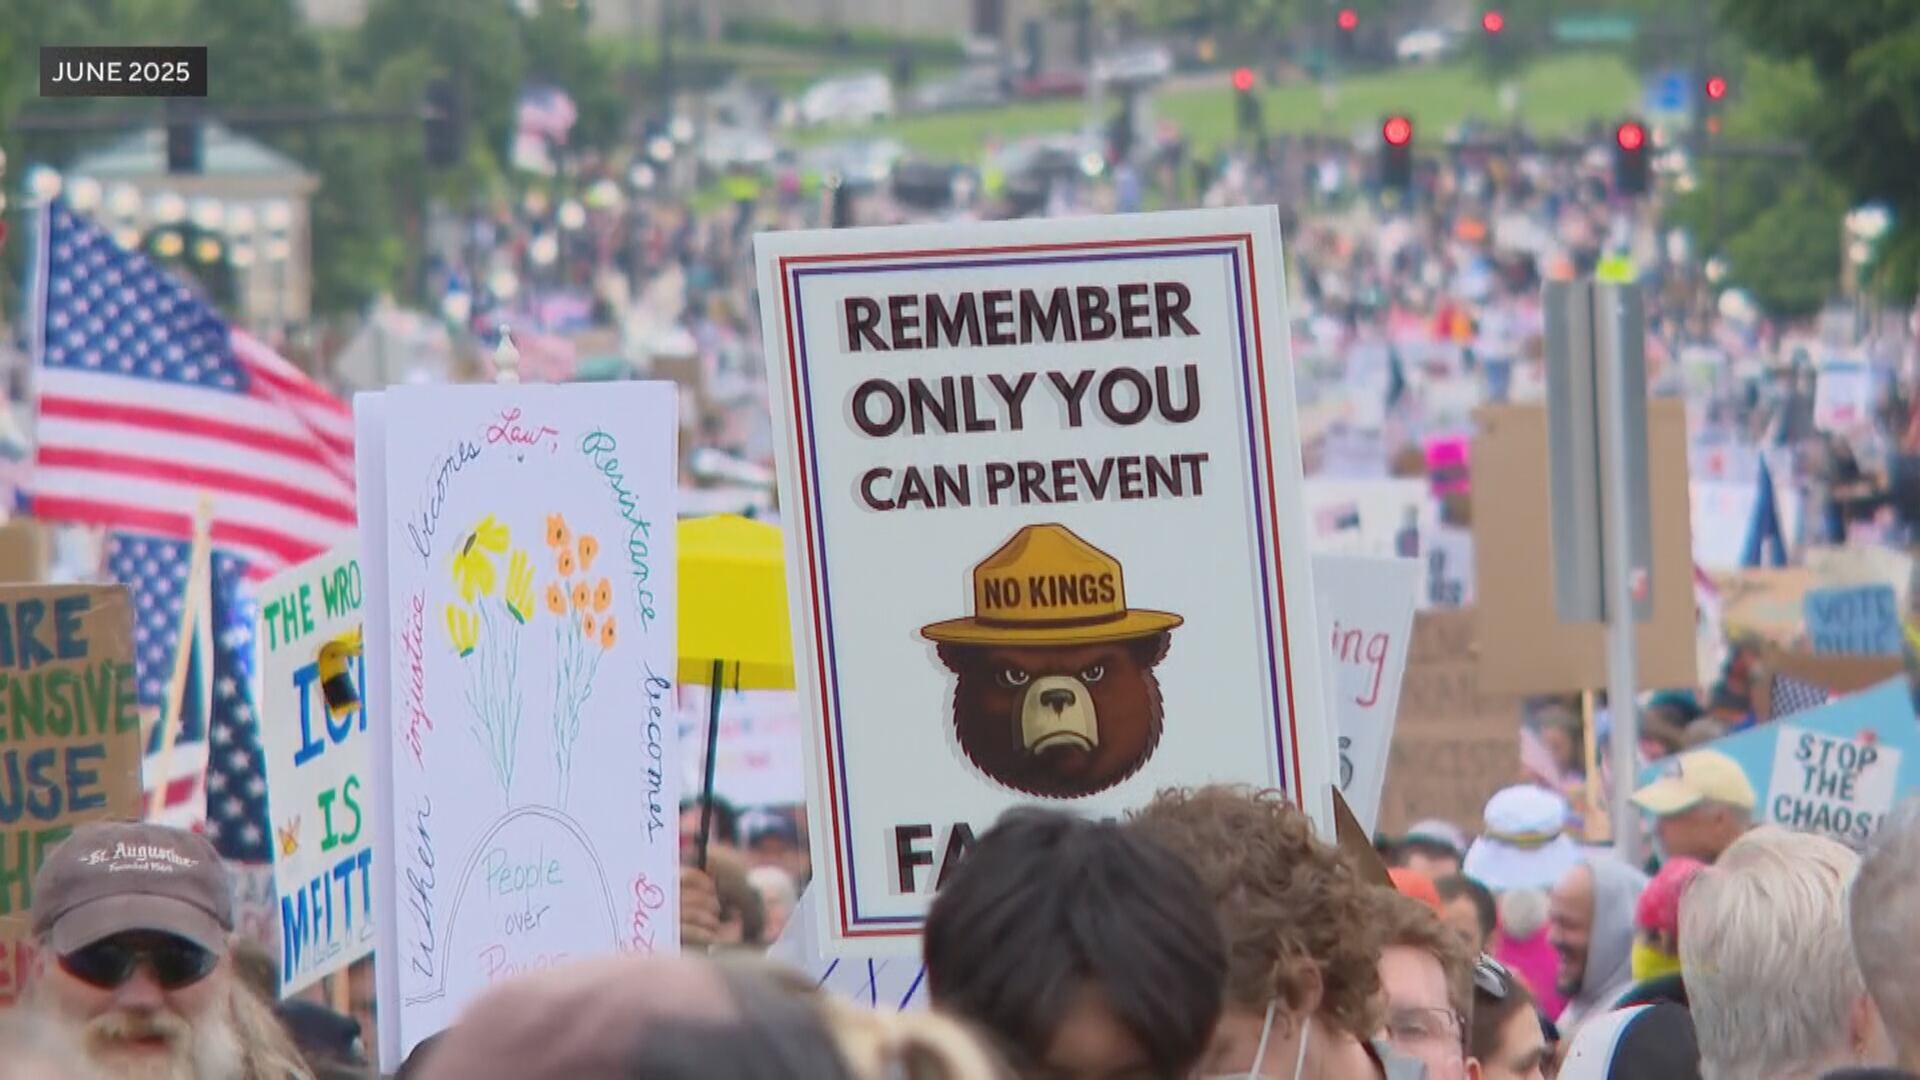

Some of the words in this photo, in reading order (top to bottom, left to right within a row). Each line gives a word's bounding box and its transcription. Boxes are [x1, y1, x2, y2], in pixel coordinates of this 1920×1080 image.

[844, 281, 1200, 352] REMEMBER
[851, 371, 1036, 437] ONLY
[1047, 364, 1200, 428] YOU
[408, 441, 481, 570] becomes
[860, 464, 969, 511] CAN
[985, 452, 1210, 506] PREVENT
[581, 425, 656, 634] Resistance
[264, 583, 315, 652] THE
[983, 577, 1022, 609] NO
[1028, 572, 1116, 608] KINGS
[401, 588, 434, 773] injustice
[643, 660, 671, 844] becomes
[1795, 733, 1878, 775] STOP
[1803, 765, 1858, 802] THE
[317, 772, 362, 852] IS
[481, 842, 564, 911] People
[504, 905, 551, 936] over
